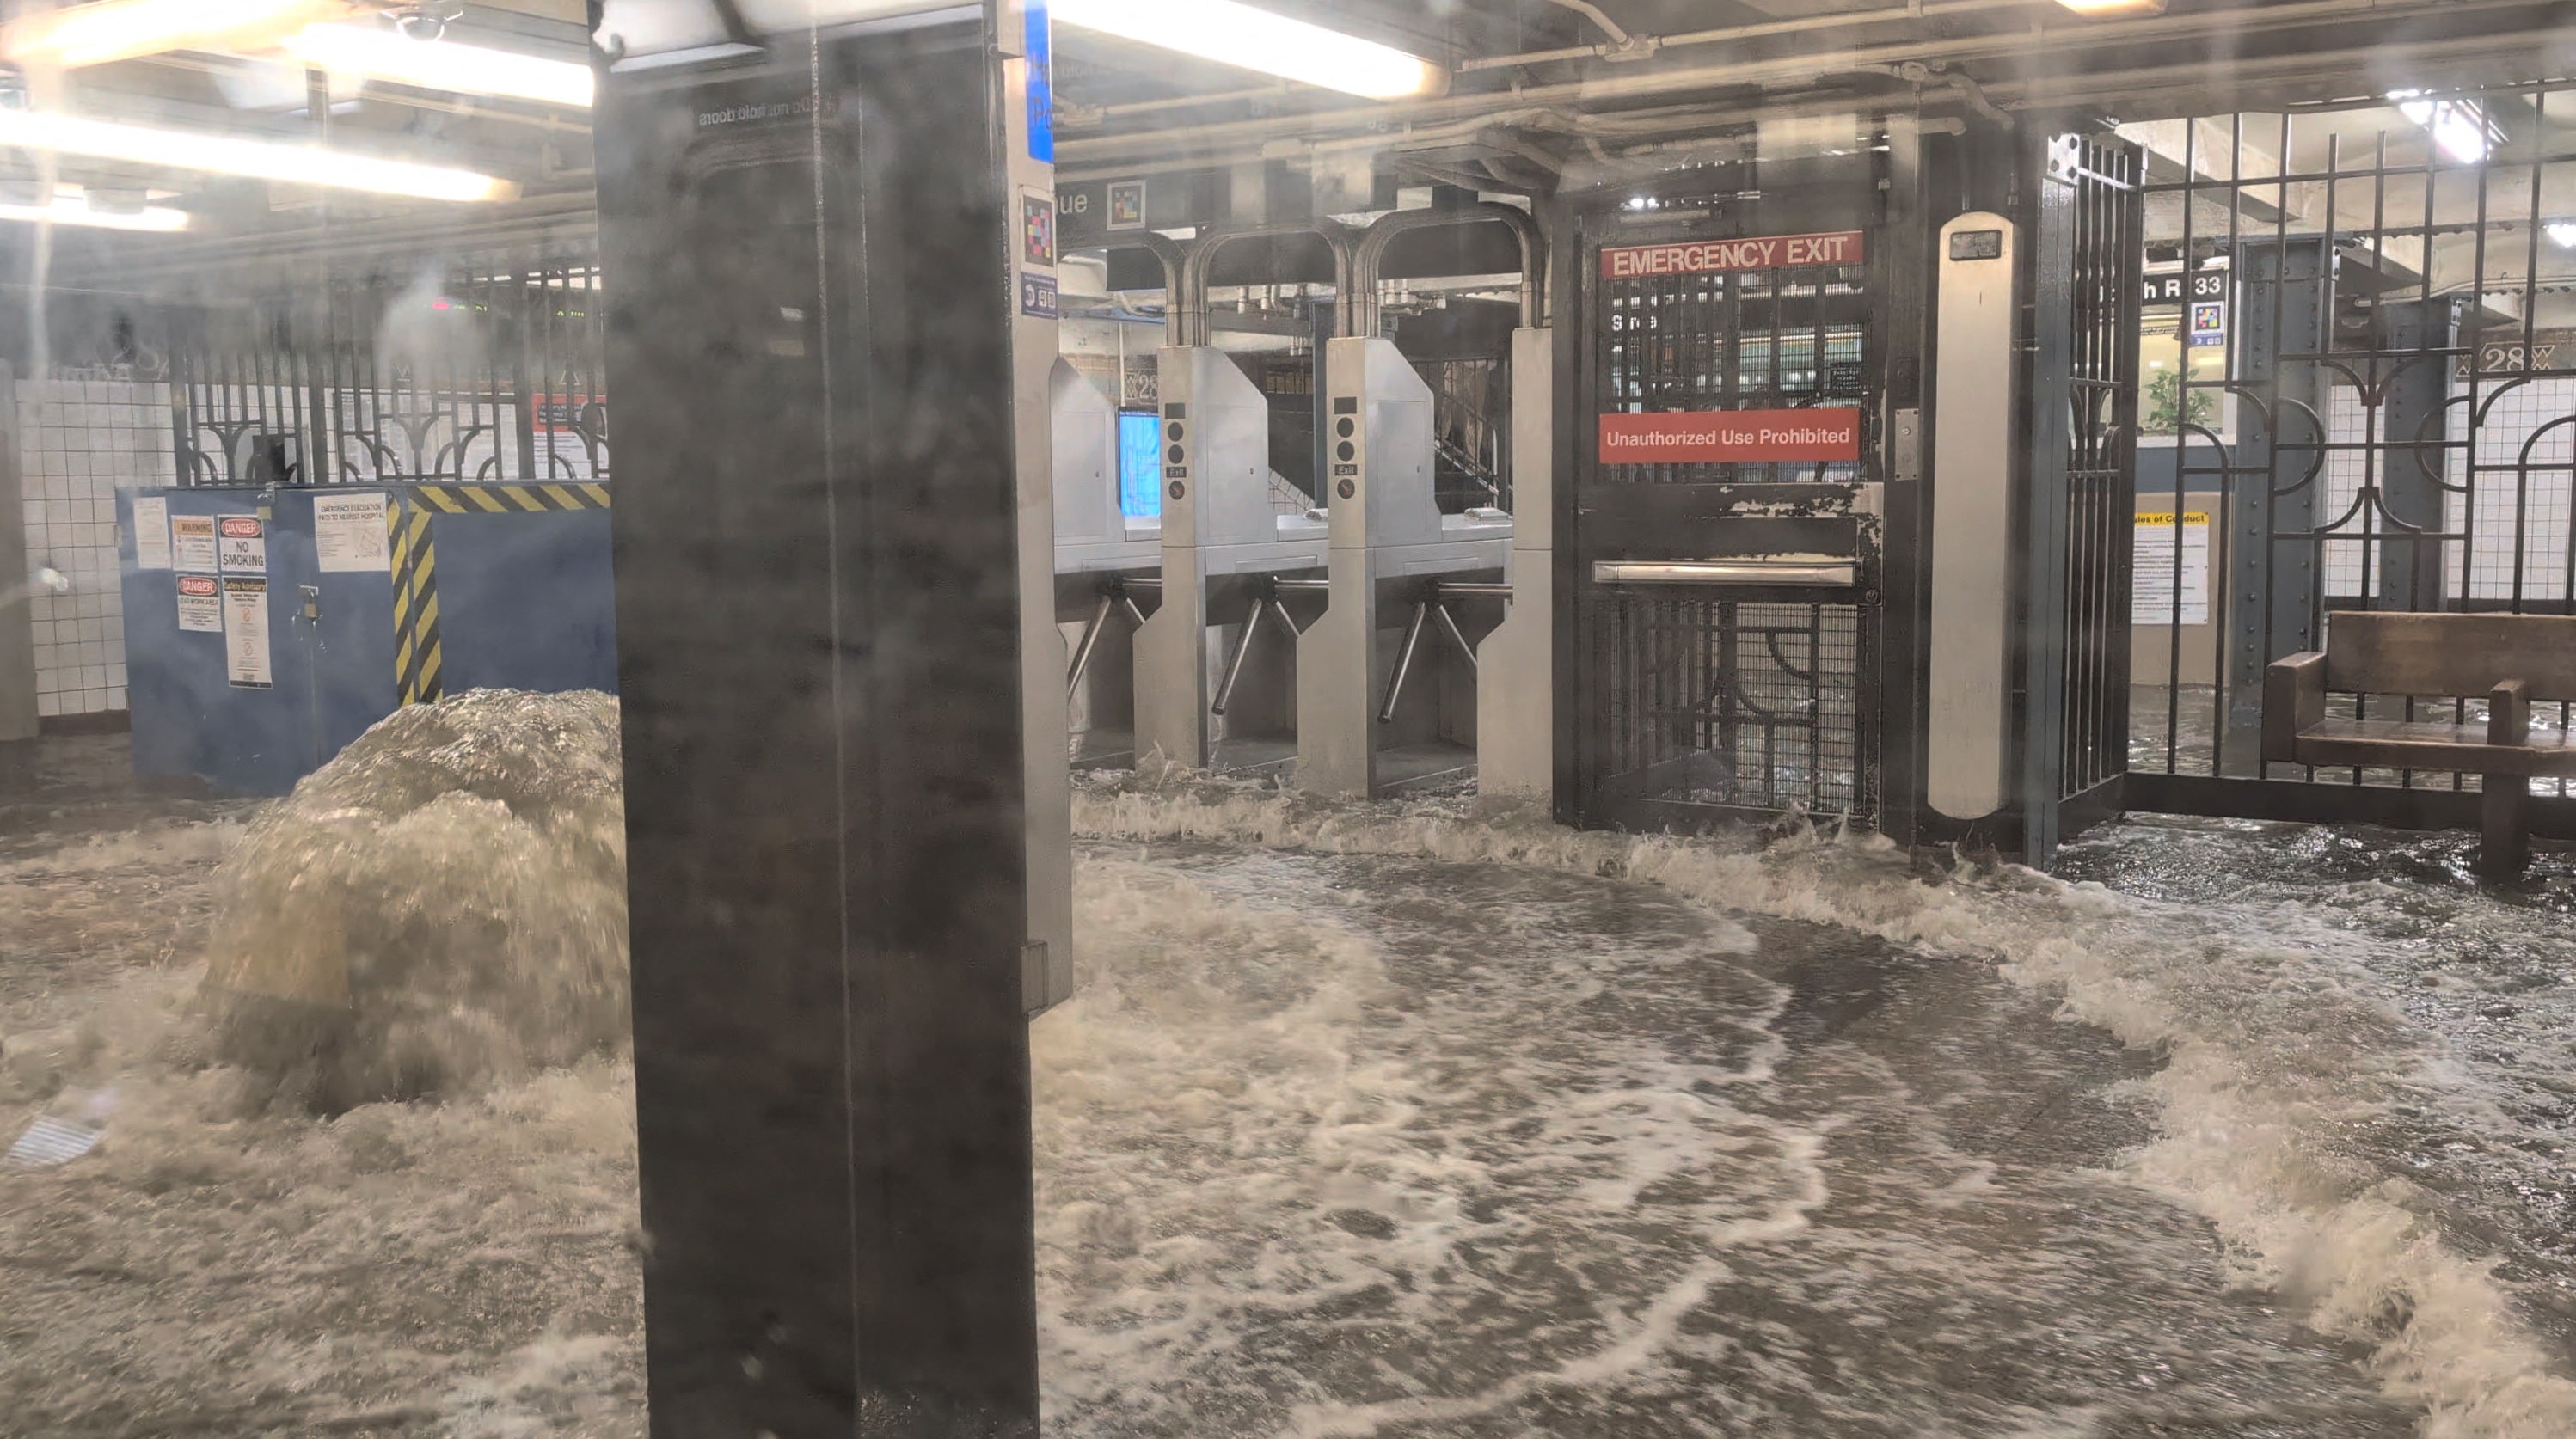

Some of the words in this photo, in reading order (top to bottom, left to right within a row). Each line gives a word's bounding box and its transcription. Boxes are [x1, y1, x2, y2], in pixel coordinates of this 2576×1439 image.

[1613, 241, 1776, 276] EMERGENCY
[1787, 236, 1849, 264] EXIT
[2194, 276, 2221, 296] 33
[2486, 346, 2524, 371] 28
[1139, 374, 1158, 399] 28
[1606, 430, 1716, 447] Unauthorized
[1721, 429, 1754, 446] Use
[1759, 427, 1850, 445] Prohibited
[1339, 466, 1354, 475] Exit
[181, 524, 212, 532] WARNING
[224, 522, 256, 533] DANGER
[236, 541, 248, 553] NO
[223, 554, 264, 566] SMOKING
[181, 580, 213, 591] DANGER
